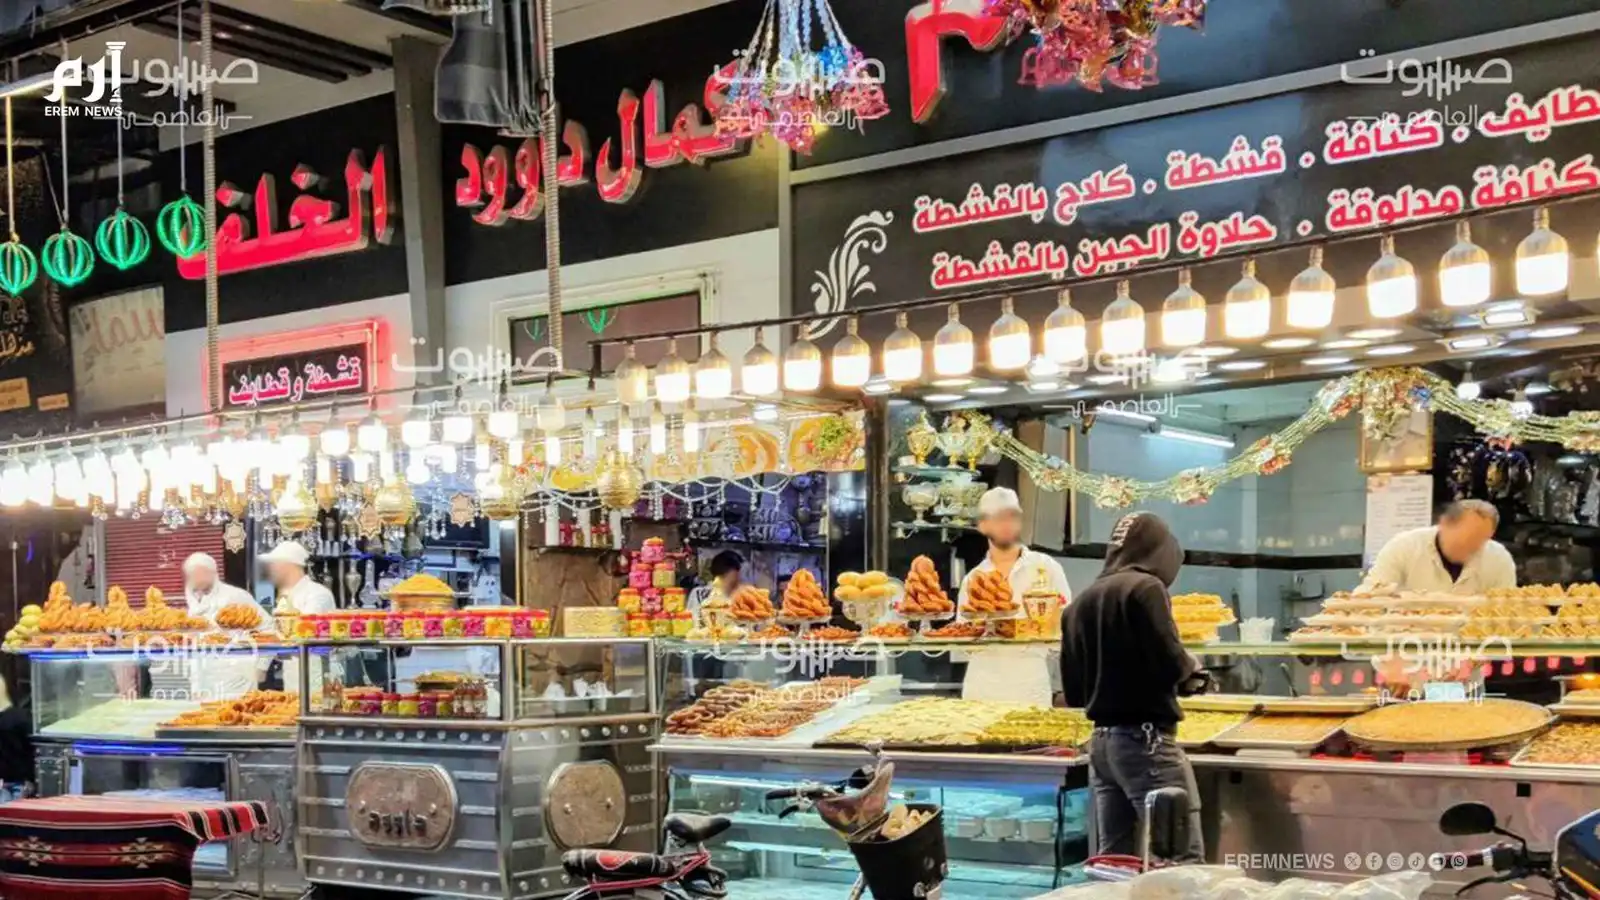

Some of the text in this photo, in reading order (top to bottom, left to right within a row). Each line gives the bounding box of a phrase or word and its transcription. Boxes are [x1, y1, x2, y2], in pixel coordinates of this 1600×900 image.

[1165, 135, 1286, 190] قشطة
[1323, 109, 1444, 164] كنافة
[913, 182, 1048, 232] بالقشطة
[931, 154, 1600, 289] كنافة مدلوقة حلاوة الجبن بالقشطة
[1053, 163, 1136, 226] كلاج
[306, 354, 362, 393] قشطة
